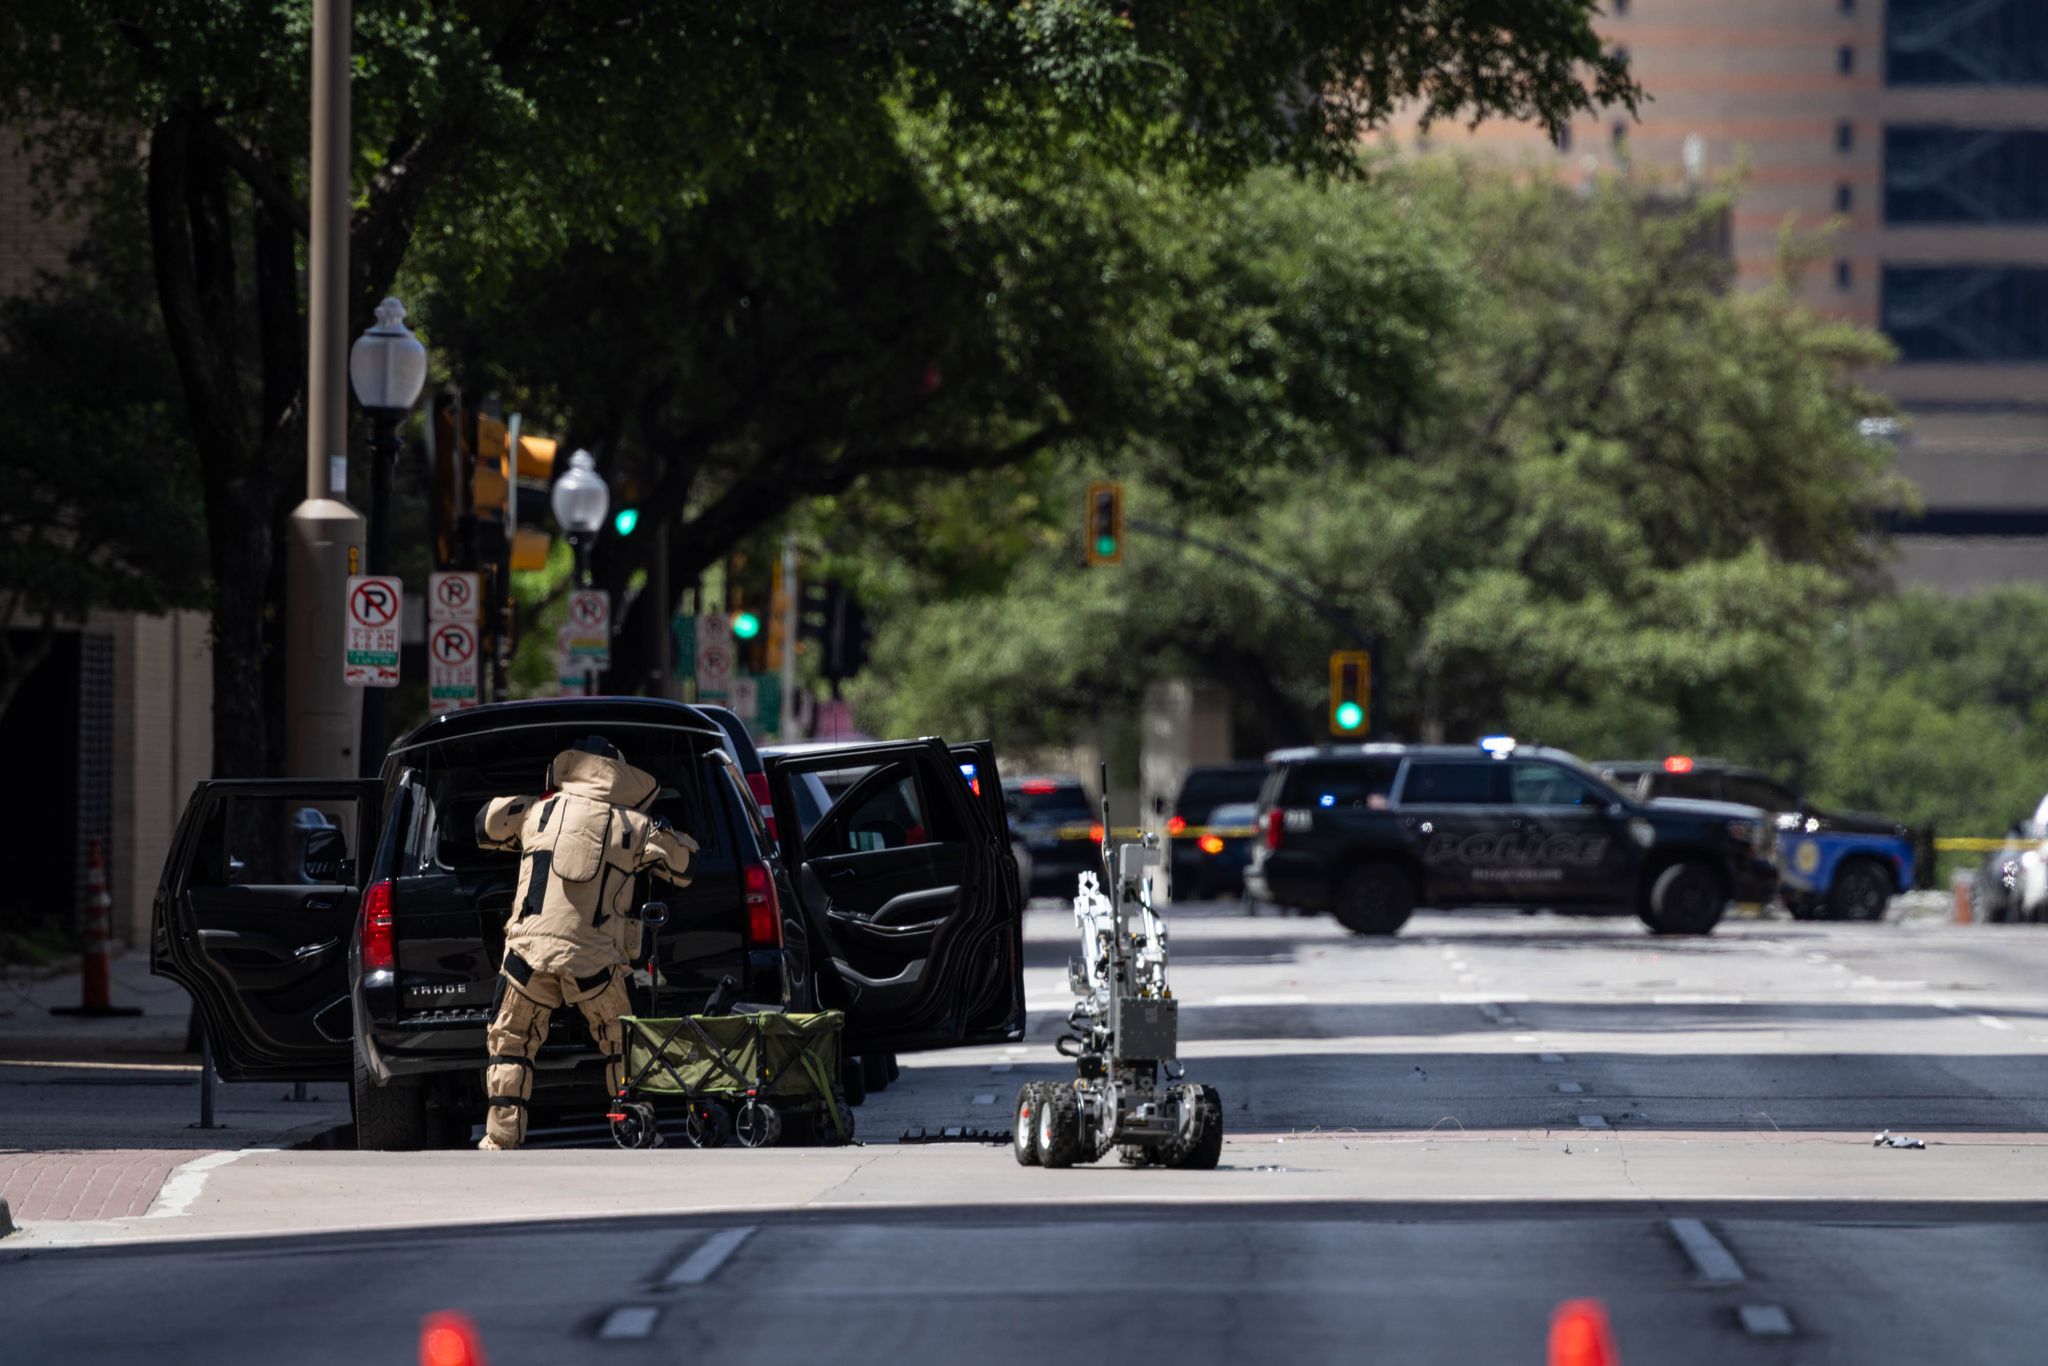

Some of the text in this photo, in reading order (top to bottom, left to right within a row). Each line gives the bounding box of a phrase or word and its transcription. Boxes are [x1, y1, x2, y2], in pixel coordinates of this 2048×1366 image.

[363, 590, 387, 619] P
[376, 632, 395, 642] AM
[444, 632, 465, 657] P
[1423, 832, 1611, 865] POLICE
[411, 984, 467, 996] TAHOE
